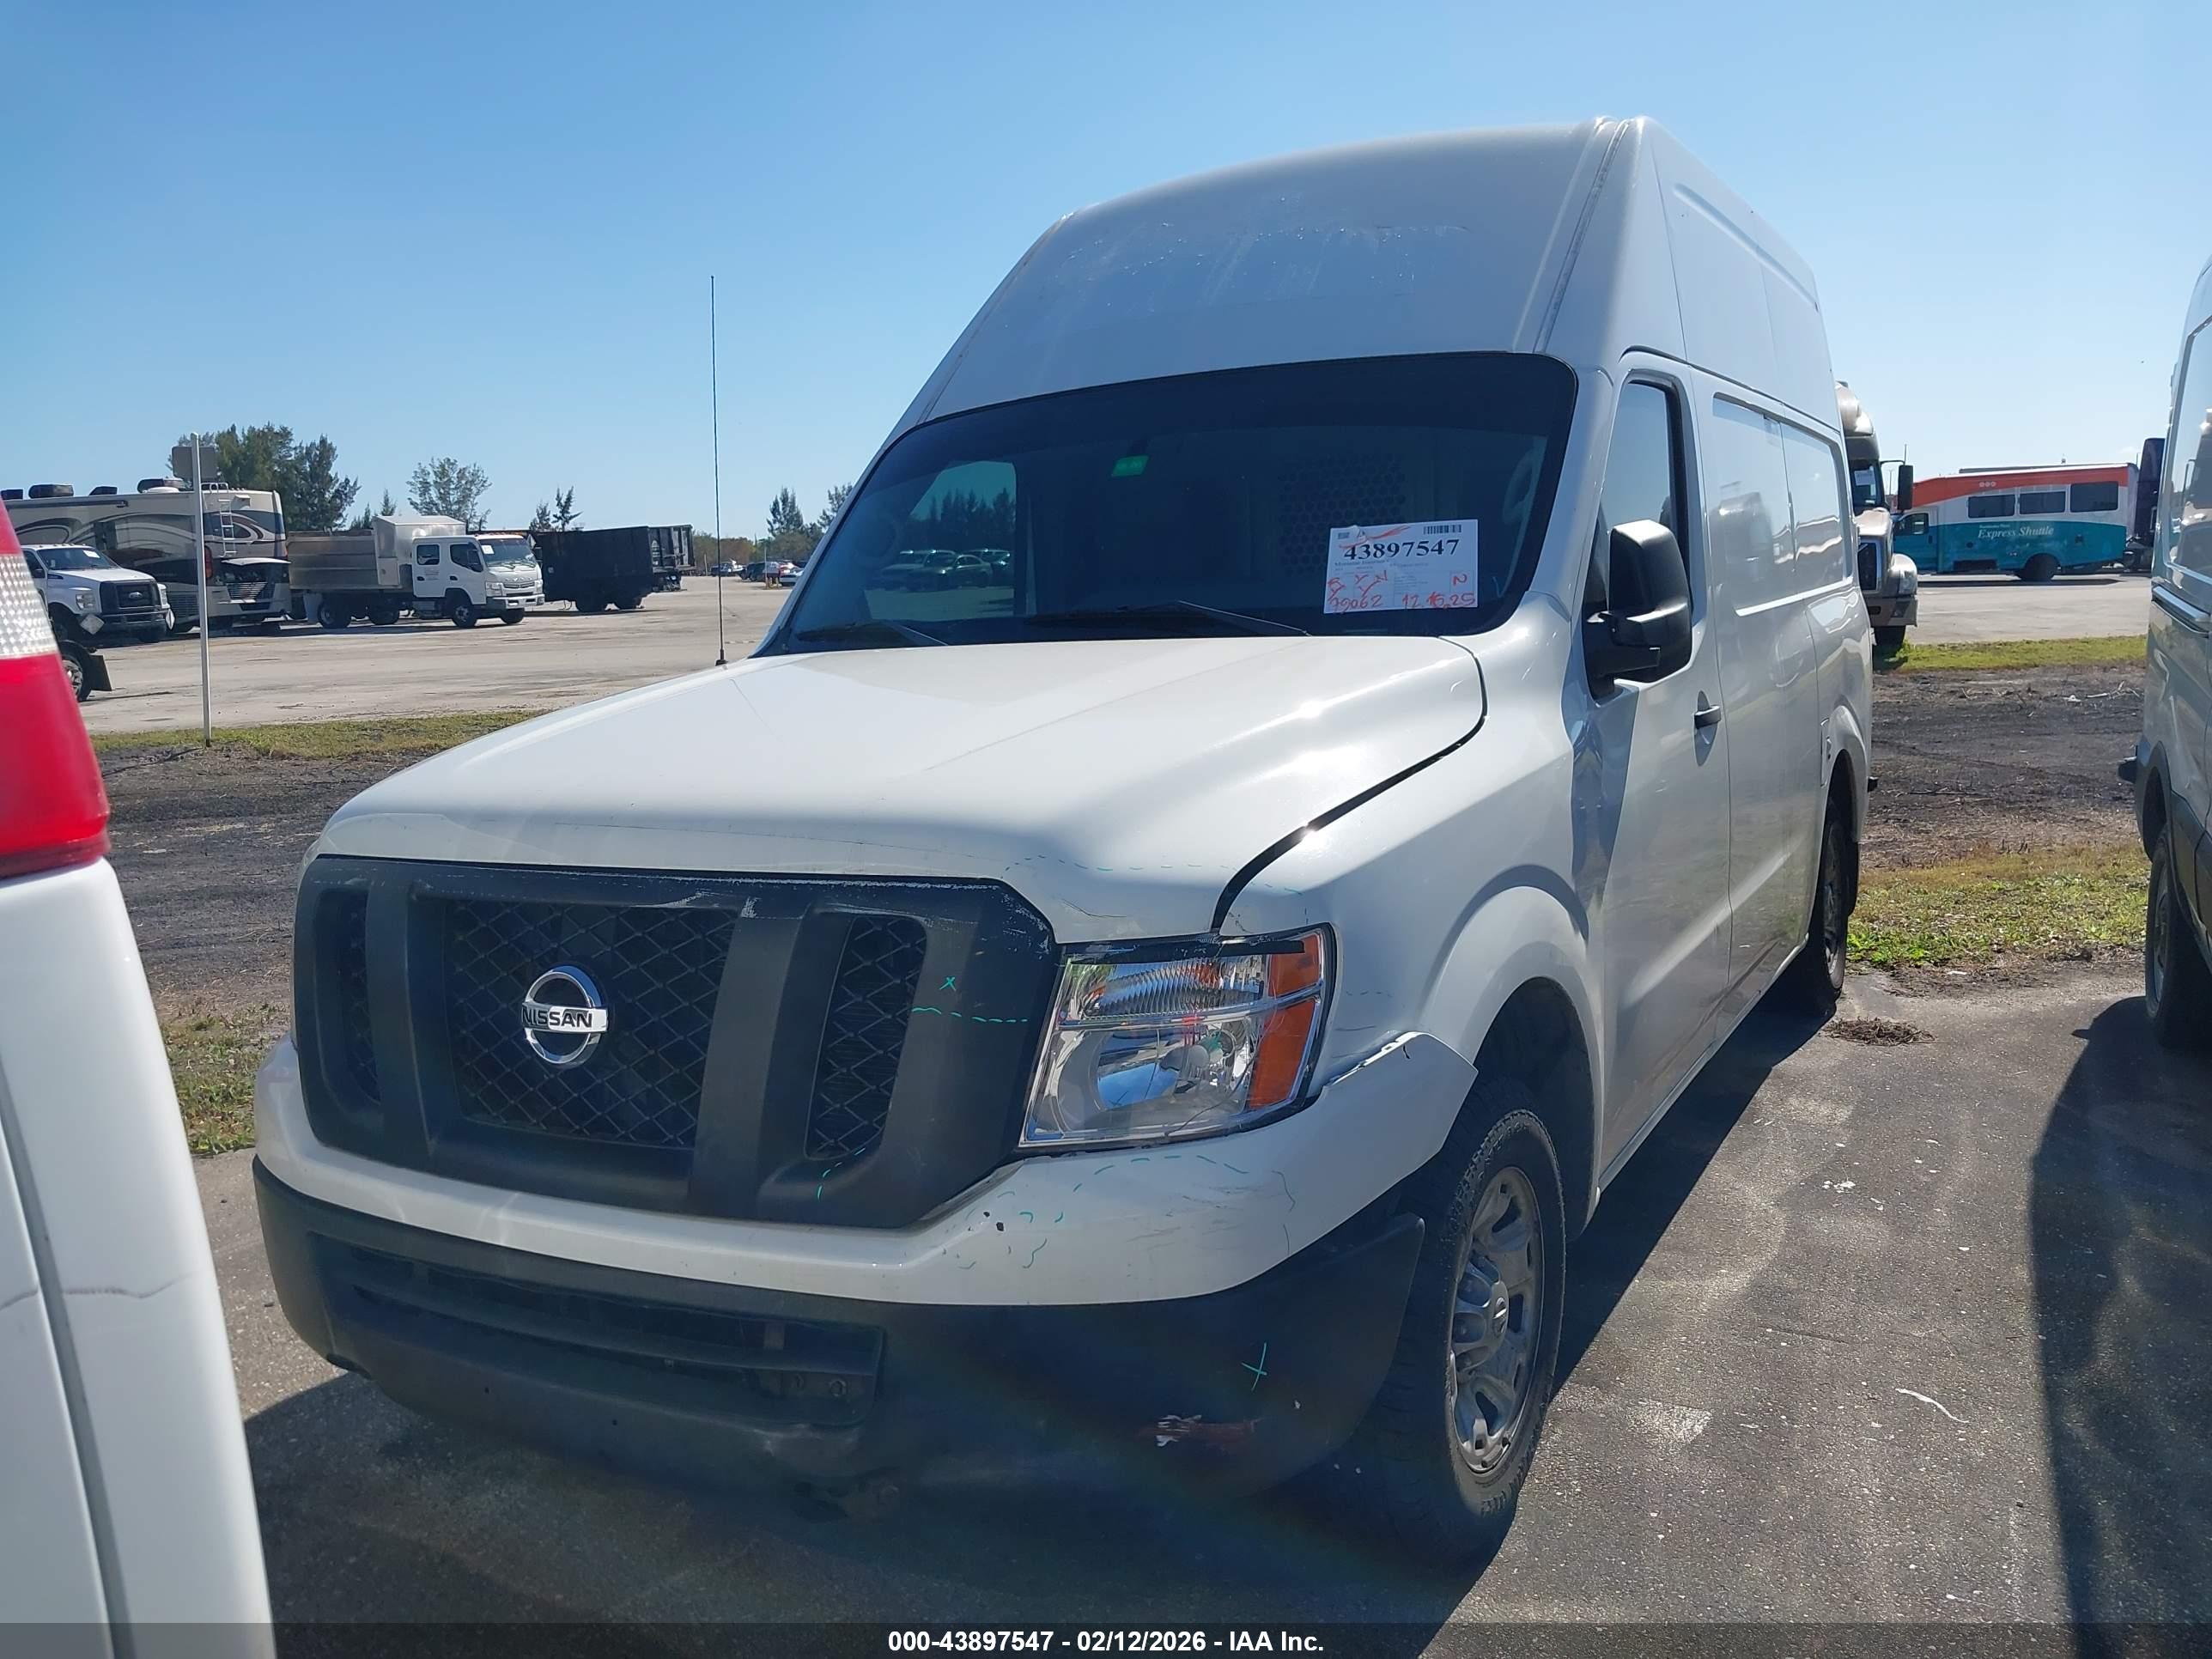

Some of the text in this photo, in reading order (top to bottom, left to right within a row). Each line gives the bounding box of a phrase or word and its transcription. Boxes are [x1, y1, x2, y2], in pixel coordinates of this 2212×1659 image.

[1978, 529, 2016, 539] Express
[2019, 526, 2054, 536] Shuttle
[1344, 539, 1460, 560] 43897547
[522, 1006, 592, 1028] NISSAN
